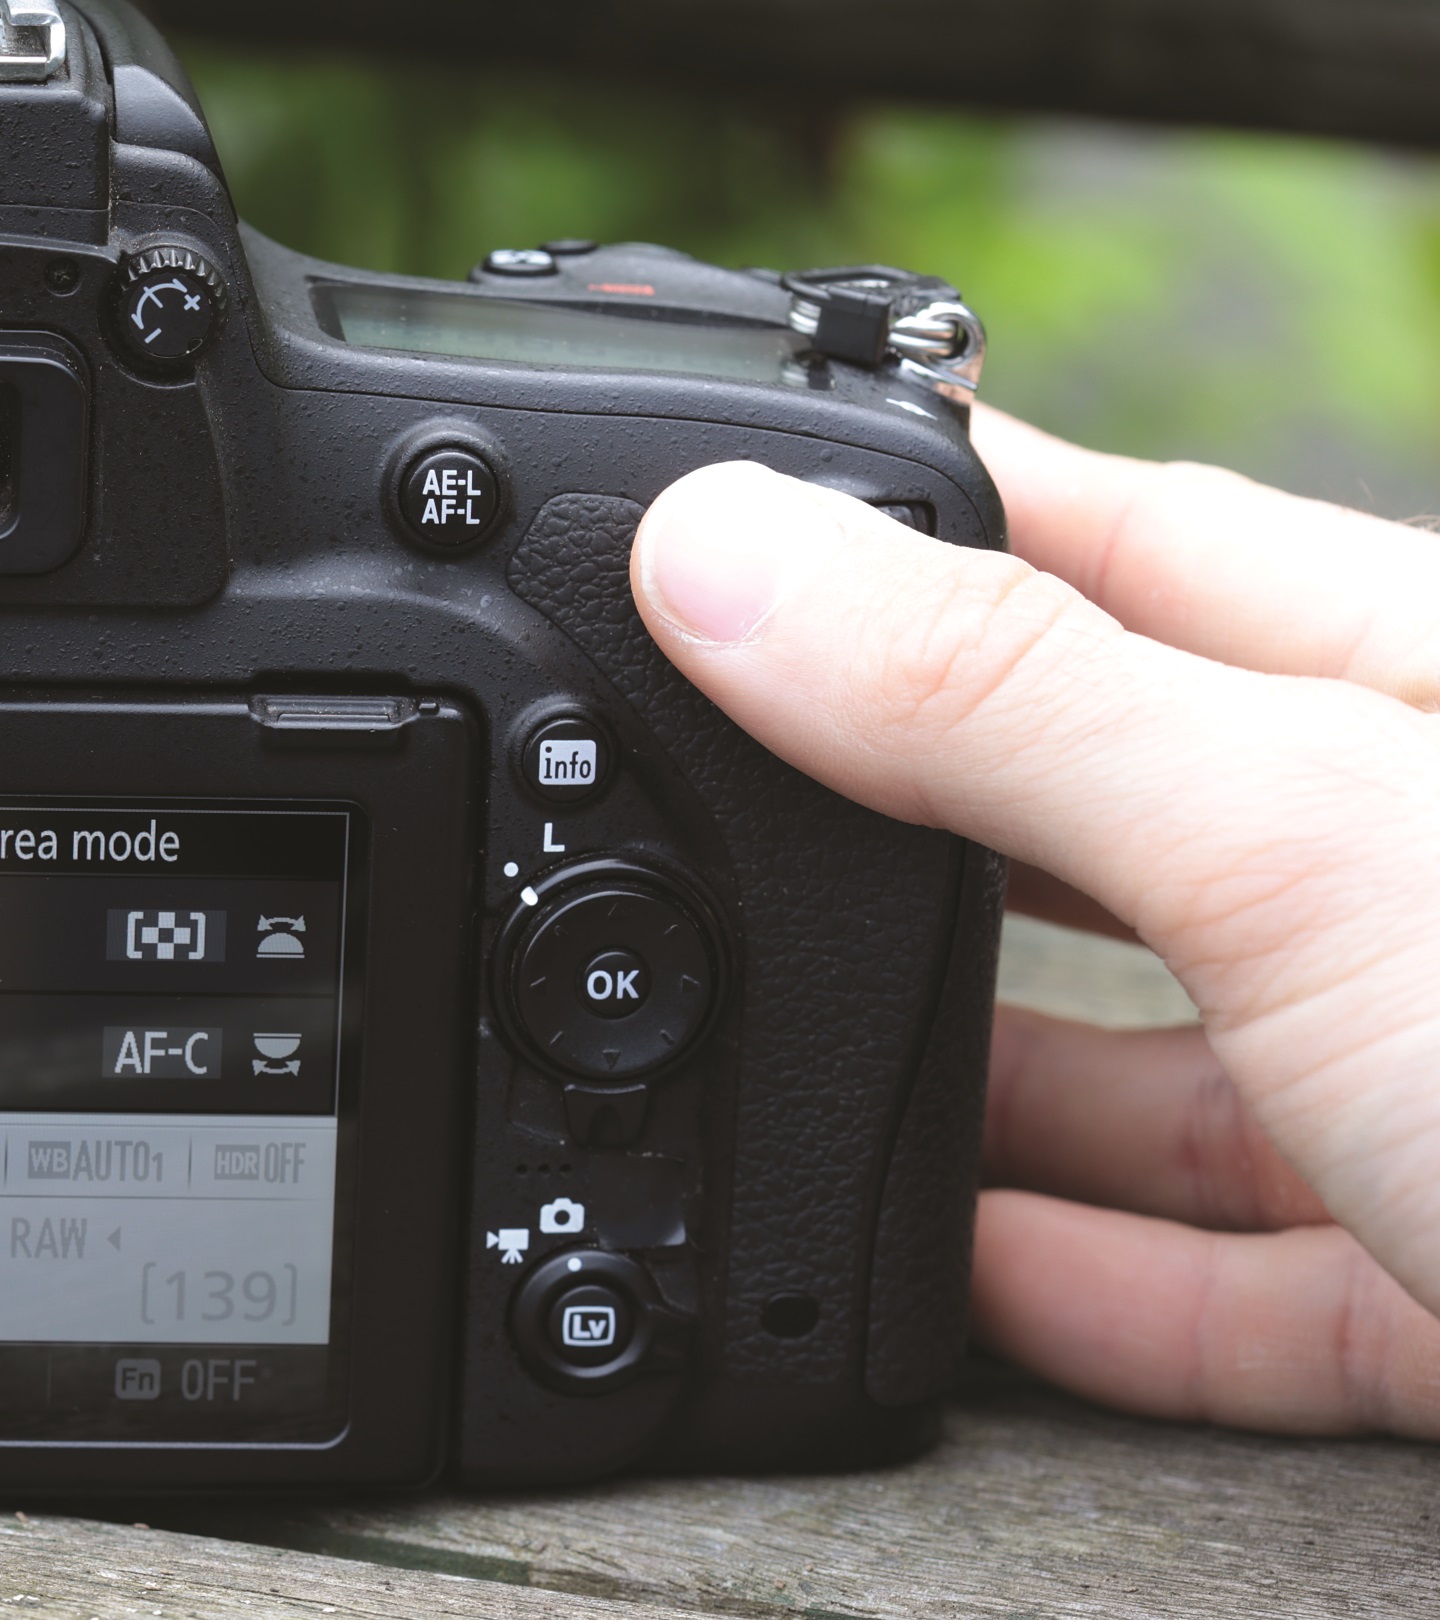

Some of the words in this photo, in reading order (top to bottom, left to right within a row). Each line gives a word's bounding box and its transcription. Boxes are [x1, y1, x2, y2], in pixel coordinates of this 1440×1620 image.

[422, 469, 482, 496] AE-L
[421, 498, 481, 525] AF-L
[543, 746, 592, 780] info
[72, 819, 180, 862] mode
[543, 822, 566, 853] L
[586, 969, 640, 1000] OK
[114, 1031, 209, 1075] AF-C
[30, 1147, 69, 1174] WB
[216, 1150, 258, 1176] HDR
[263, 1142, 307, 1185] OFF
[10, 1216, 88, 1260] RAW
[572, 1314, 607, 1339] Lv
[120, 1366, 155, 1392] Fn
[181, 1358, 258, 1402] OFF
